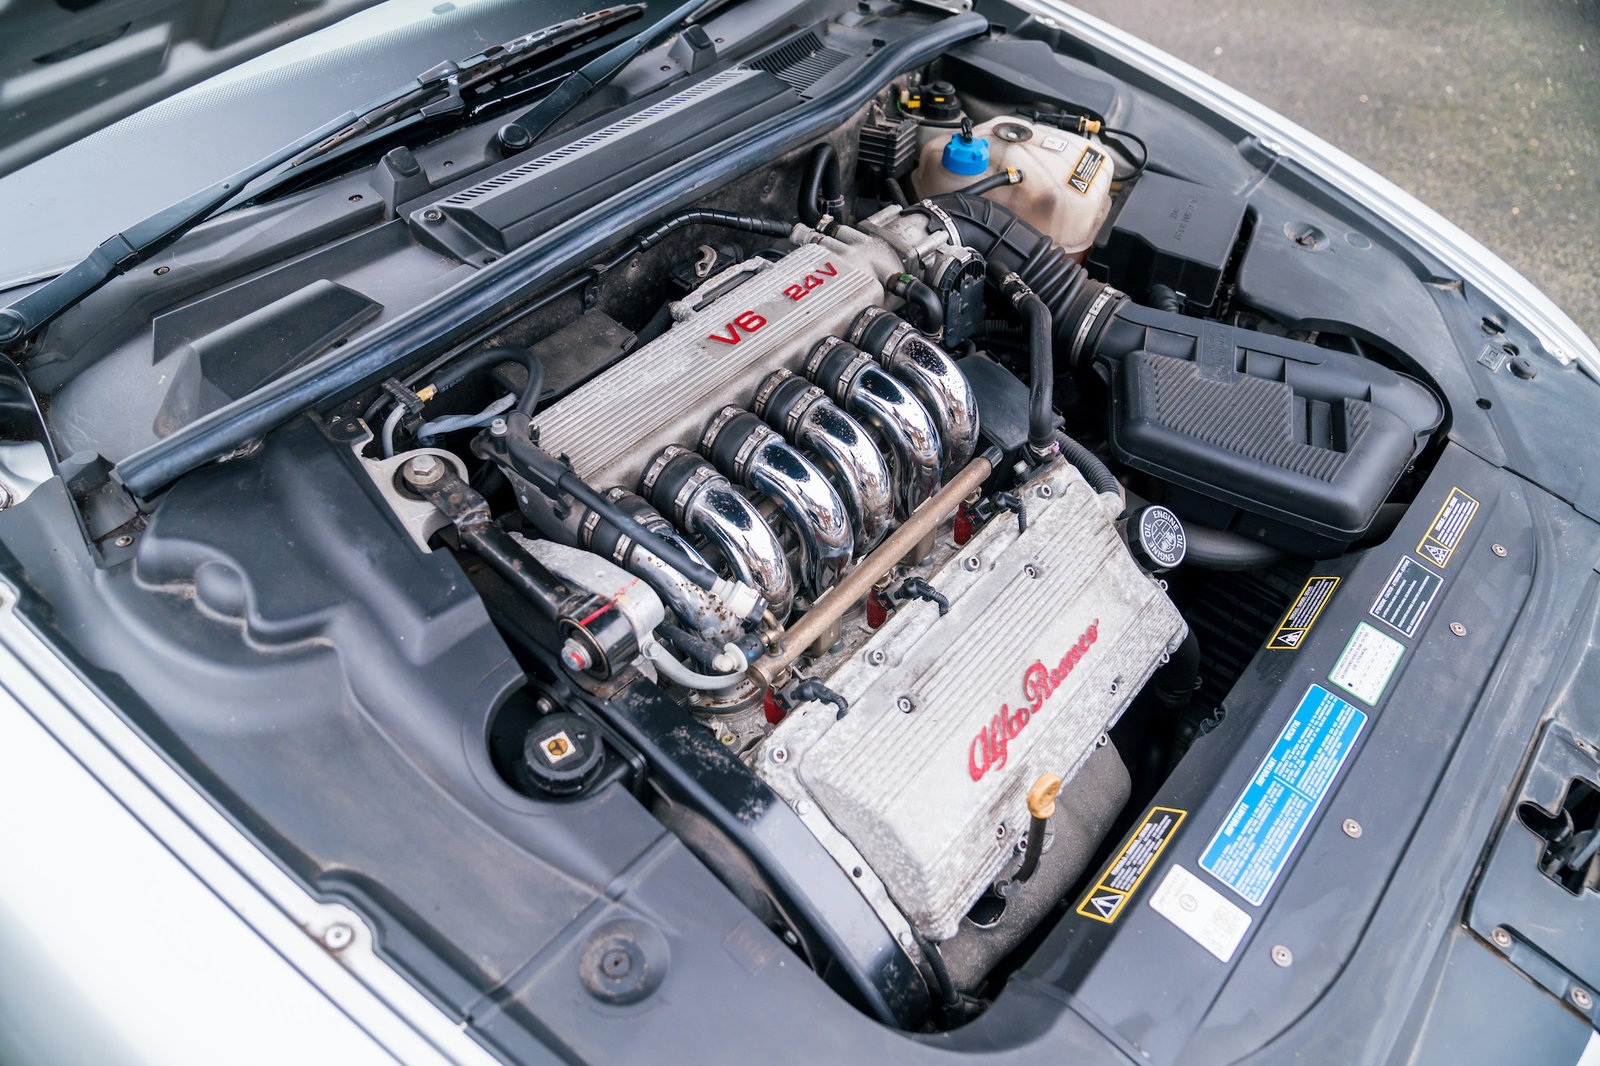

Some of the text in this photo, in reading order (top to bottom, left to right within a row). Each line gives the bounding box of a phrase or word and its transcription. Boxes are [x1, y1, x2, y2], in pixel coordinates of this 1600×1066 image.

[707, 262, 838, 345] V6 24V
[1144, 523, 1152, 538] OIL
[1152, 510, 1179, 531] ENGINE
[1148, 540, 1175, 562] ENGINE
[969, 618, 1099, 782] Alfa Romeo
[1223, 801, 1250, 837] IMPORTANTE
[1254, 756, 1278, 787] IMPORTANT
